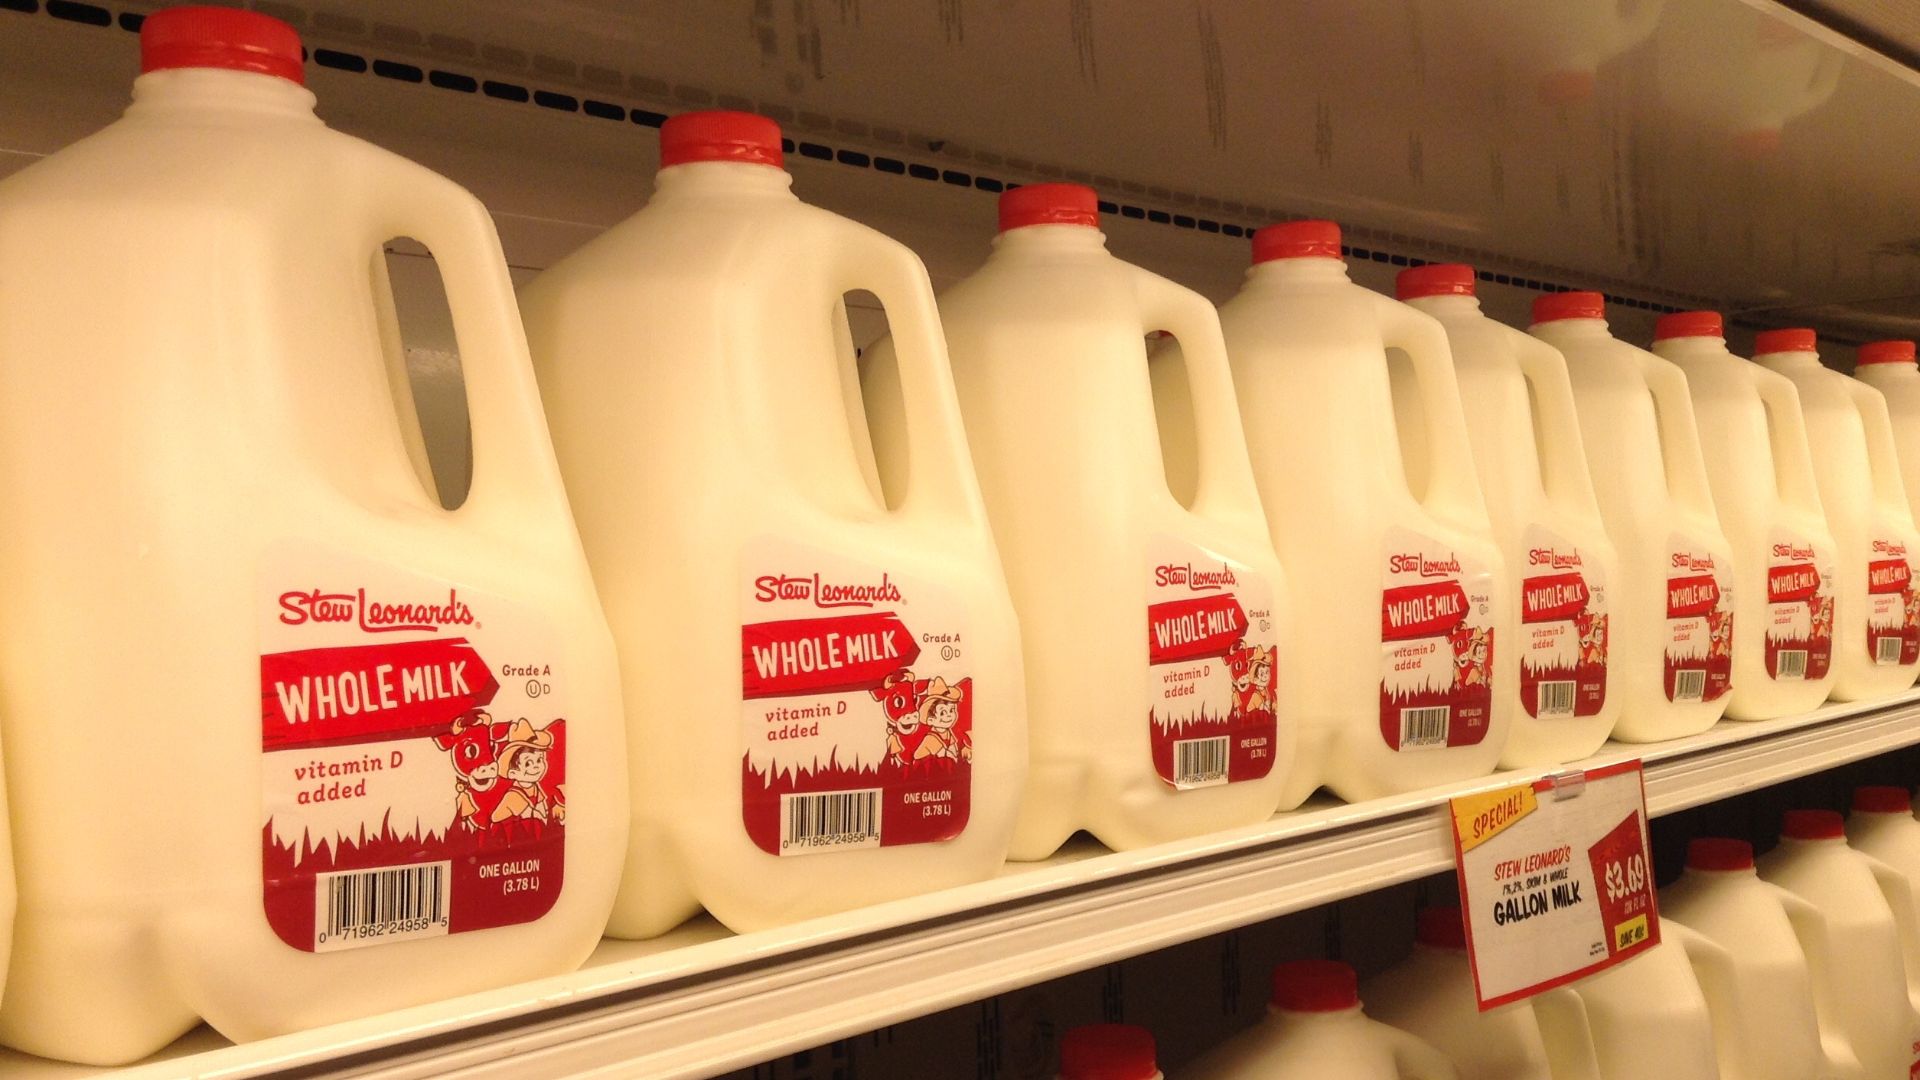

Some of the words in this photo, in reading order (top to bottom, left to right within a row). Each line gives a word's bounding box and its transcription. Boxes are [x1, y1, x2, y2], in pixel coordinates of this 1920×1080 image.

[1390, 553, 1419, 573] Stew
[1420, 552, 1461, 577] Leonard's
[1155, 564, 1187, 587] Stew
[1188, 562, 1236, 590] Leonard's
[1771, 572, 1799, 594] WHOLE
[755, 574, 812, 602] Stew
[814, 572, 901, 608] Leonard's
[1527, 584, 1564, 612] WHOLE
[1564, 584, 1582, 602] MILK
[1671, 585, 1698, 608] WHOLE
[1699, 585, 1714, 601] MILK
[278, 589, 355, 626] Stew
[358, 588, 475, 632] Leonard's
[1388, 595, 1434, 628] WHOLE
[1435, 593, 1459, 617] MILK
[922, 633, 952, 643] Grade
[954, 634, 961, 642] A
[1154, 610, 1207, 649] WHOLE
[1208, 607, 1237, 635] MILK
[1532, 626, 1556, 638] vitamin
[752, 632, 842, 680] WHOLE
[846, 630, 898, 664] MILK
[1394, 645, 1428, 659] vitamin
[1430, 643, 1436, 653] D
[1532, 639, 1554, 650] added
[502, 664, 540, 677] Grade
[542, 665, 551, 676] A
[1163, 668, 1201, 684] vitamin
[1204, 665, 1210, 677] D
[1395, 658, 1421, 671] added
[275, 664, 398, 725] WHOLE
[401, 661, 470, 705] MILK
[1165, 683, 1195, 699] added
[766, 703, 831, 722] vitamin
[837, 701, 847, 714] D
[767, 723, 818, 741] added
[1241, 740, 1250, 748] ONE
[294, 754, 383, 781] vitamin
[390, 750, 403, 769] D
[297, 780, 367, 804] added
[904, 792, 920, 804] ONE
[922, 790, 952, 802] GALLON
[922, 805, 942, 818] (3.78
[943, 804, 950, 816] L)
[1473, 791, 1522, 839] SPECIAL!
[800, 835, 831, 848] 71962
[834, 832, 865, 844] 24958
[479, 864, 499, 879] ONE
[501, 859, 540, 876] GALLON
[1495, 858, 1522, 881] STEW
[1525, 844, 1571, 873] LEONARD'S
[503, 878, 529, 895] (3.78
[530, 877, 540, 891] L)
[1605, 854, 1644, 904] $3.69
[1494, 889, 1548, 926] GALLON
[1552, 880, 1582, 910] MILK
[342, 923, 385, 941] 71962
[389, 918, 429, 935] 24958
